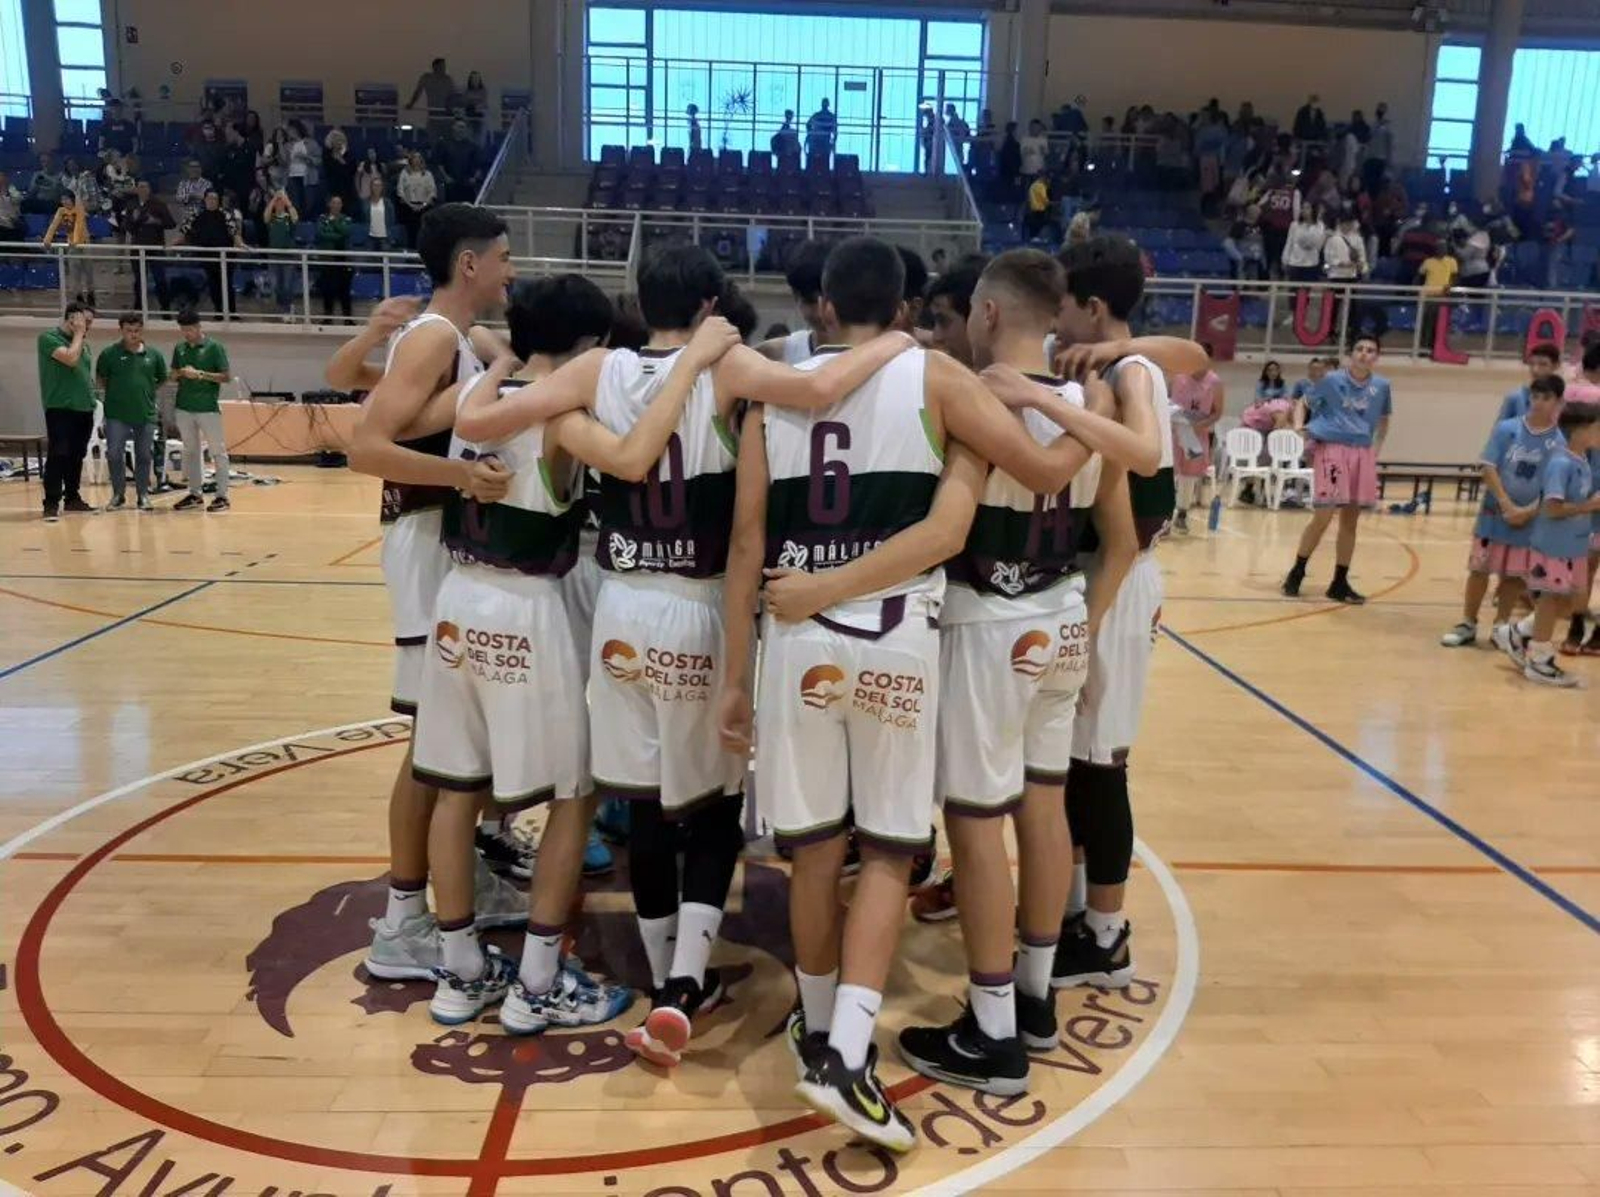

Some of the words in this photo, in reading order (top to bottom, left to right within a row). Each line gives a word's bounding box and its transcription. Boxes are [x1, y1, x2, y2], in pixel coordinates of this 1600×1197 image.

[808, 421, 851, 524] 6
[466, 628, 531, 653] COSTA
[1060, 621, 1088, 640] COS
[467, 647, 490, 666] DEL
[495, 653, 531, 670] SOL
[646, 647, 714, 671] COSTA
[1059, 643, 1081, 658] DEL
[645, 665, 672, 686] DEL
[677, 673, 710, 687] SOL
[858, 670, 924, 694] COSTA
[854, 687, 888, 707] DEL
[890, 696, 921, 713] SOL
[174, 743, 335, 785] Vera
[921, 1090, 1047, 1155] de
[1029, 976, 1161, 1076] Vera
